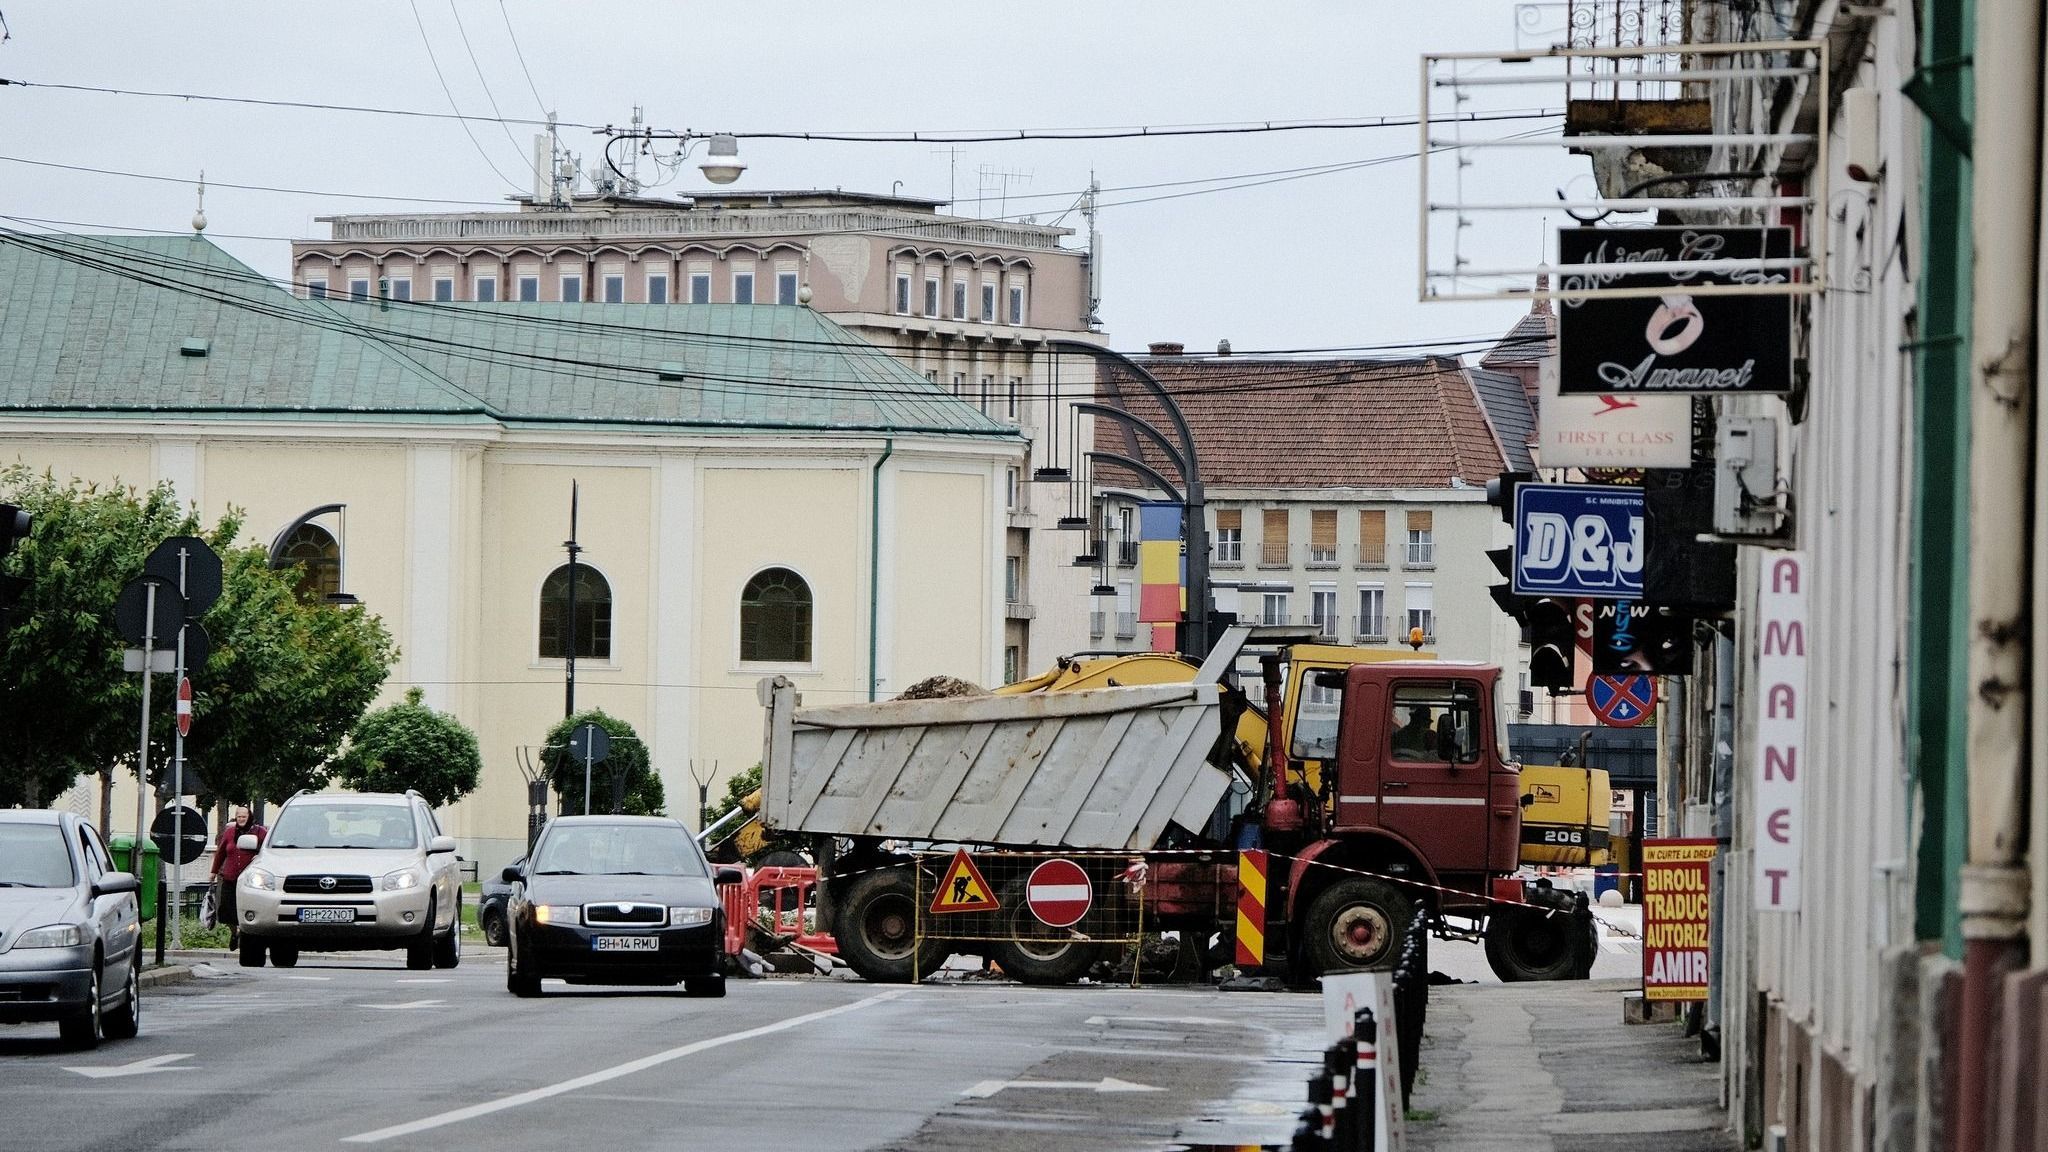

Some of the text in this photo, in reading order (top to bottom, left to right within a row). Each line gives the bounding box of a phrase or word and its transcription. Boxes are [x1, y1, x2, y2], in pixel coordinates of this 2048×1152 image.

[1597, 353, 1755, 388] Amanet
[1557, 431, 1674, 444] FIRST CLASS
[1584, 447, 1647, 457] TRAVEL
[1763, 557, 1805, 906] AMANET
[1544, 830, 1582, 843] 206
[1646, 850, 1655, 860] IN
[1656, 850, 1681, 860] CURTE
[1682, 850, 1692, 859] LA
[1647, 868, 1706, 891] BIROUL
[1652, 950, 1707, 984] AMIR
